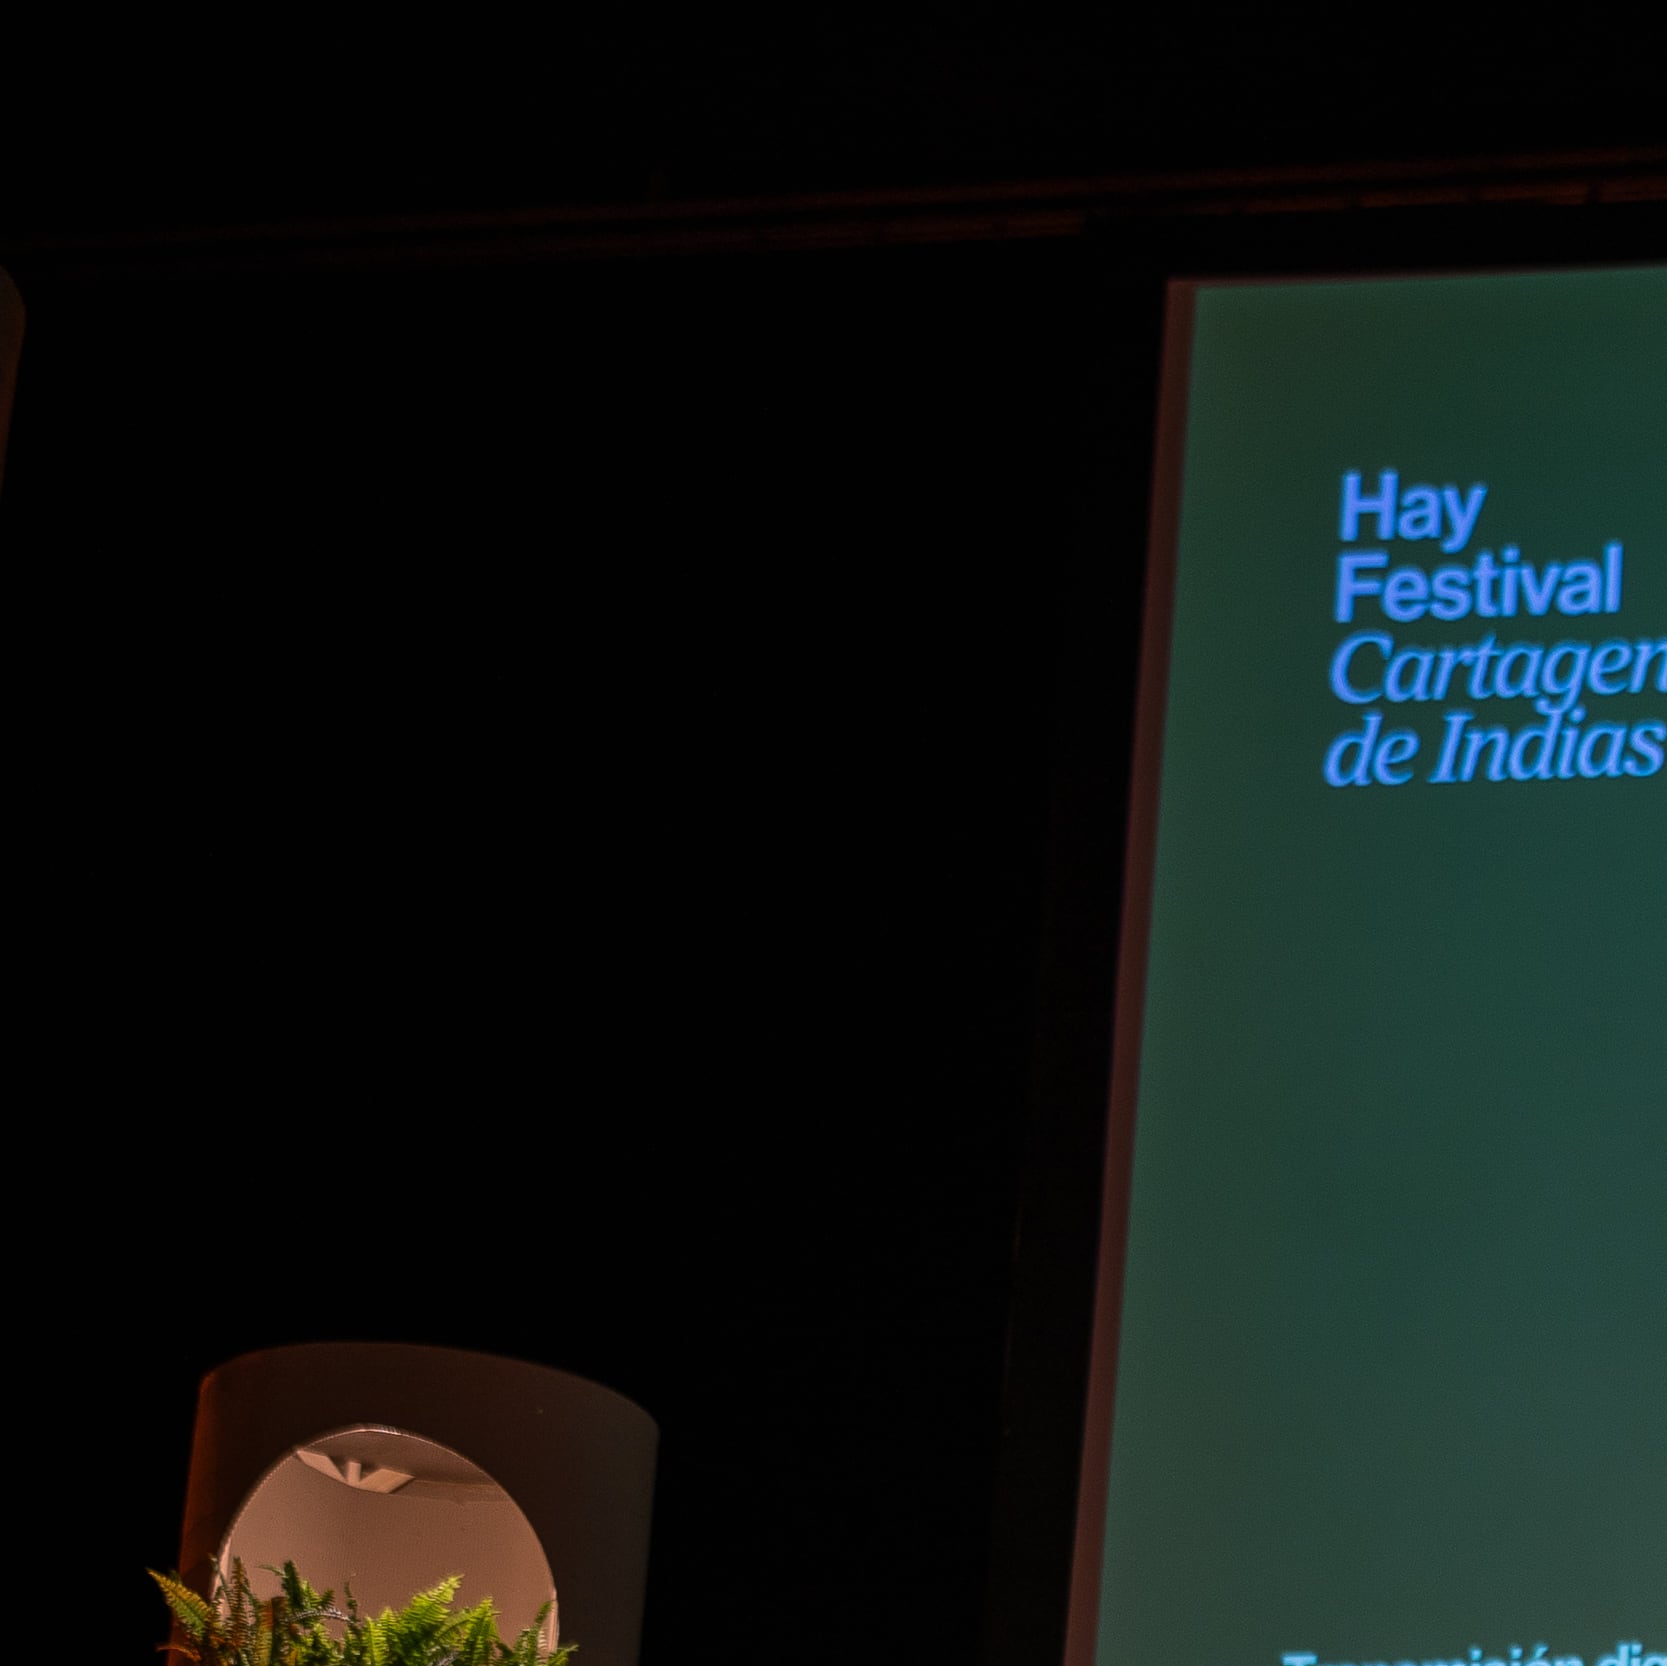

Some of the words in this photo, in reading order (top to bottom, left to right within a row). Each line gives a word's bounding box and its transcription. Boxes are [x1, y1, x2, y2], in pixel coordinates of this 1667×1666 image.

[1339, 468, 1487, 553] Hay
[1334, 540, 1623, 623] Festival
[1323, 710, 1420, 788] de
[1426, 706, 1667, 783] Indias
